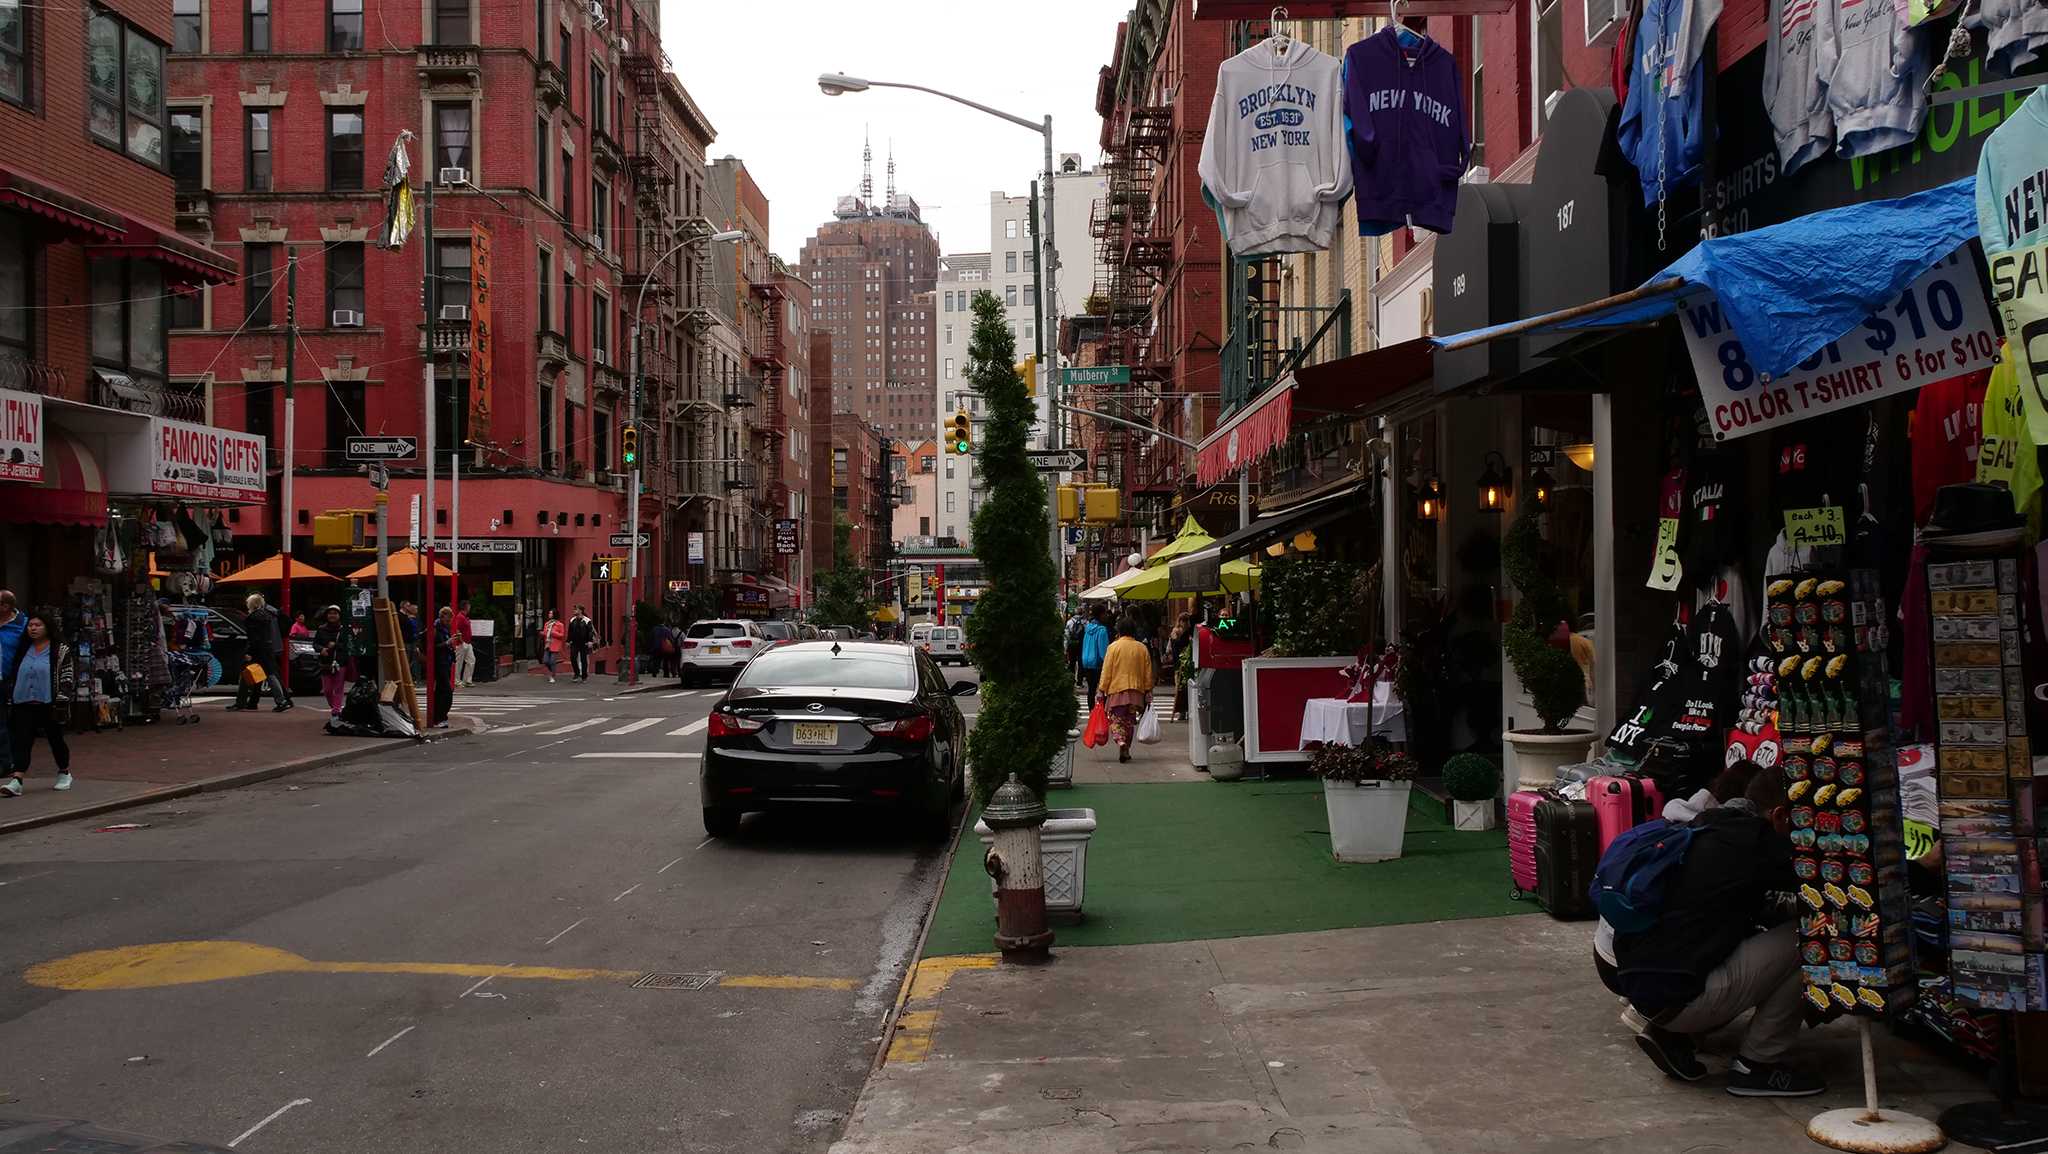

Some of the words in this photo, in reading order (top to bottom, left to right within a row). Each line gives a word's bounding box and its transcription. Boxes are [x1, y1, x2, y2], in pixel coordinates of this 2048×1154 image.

[1238, 83, 1316, 119] BROOKLYN
[1369, 89, 1406, 112] NEW
[1413, 91, 1452, 128] YORK
[1251, 131, 1278, 152] NEW
[1281, 130, 1310, 146] YORK
[1557, 200, 1575, 235] 187
[1453, 273, 1466, 297] 189
[1865, 279, 1964, 356] $10
[1071, 369, 1109, 382] Mulberry
[1715, 388, 1793, 432] COLOR
[1795, 361, 1882, 409] T-SHIRT
[1896, 354, 1911, 381] 6
[1916, 350, 1946, 376] for
[1951, 331, 1993, 367] $10
[6, 399, 39, 444] ITALY
[163, 426, 217, 469] FAMOUS
[223, 437, 259, 474] GIFTS
[352, 443, 375, 453] ONE
[387, 443, 409, 452] WAY
[1057, 456, 1078, 465] WAY
[1610, 723, 1646, 746] NY
